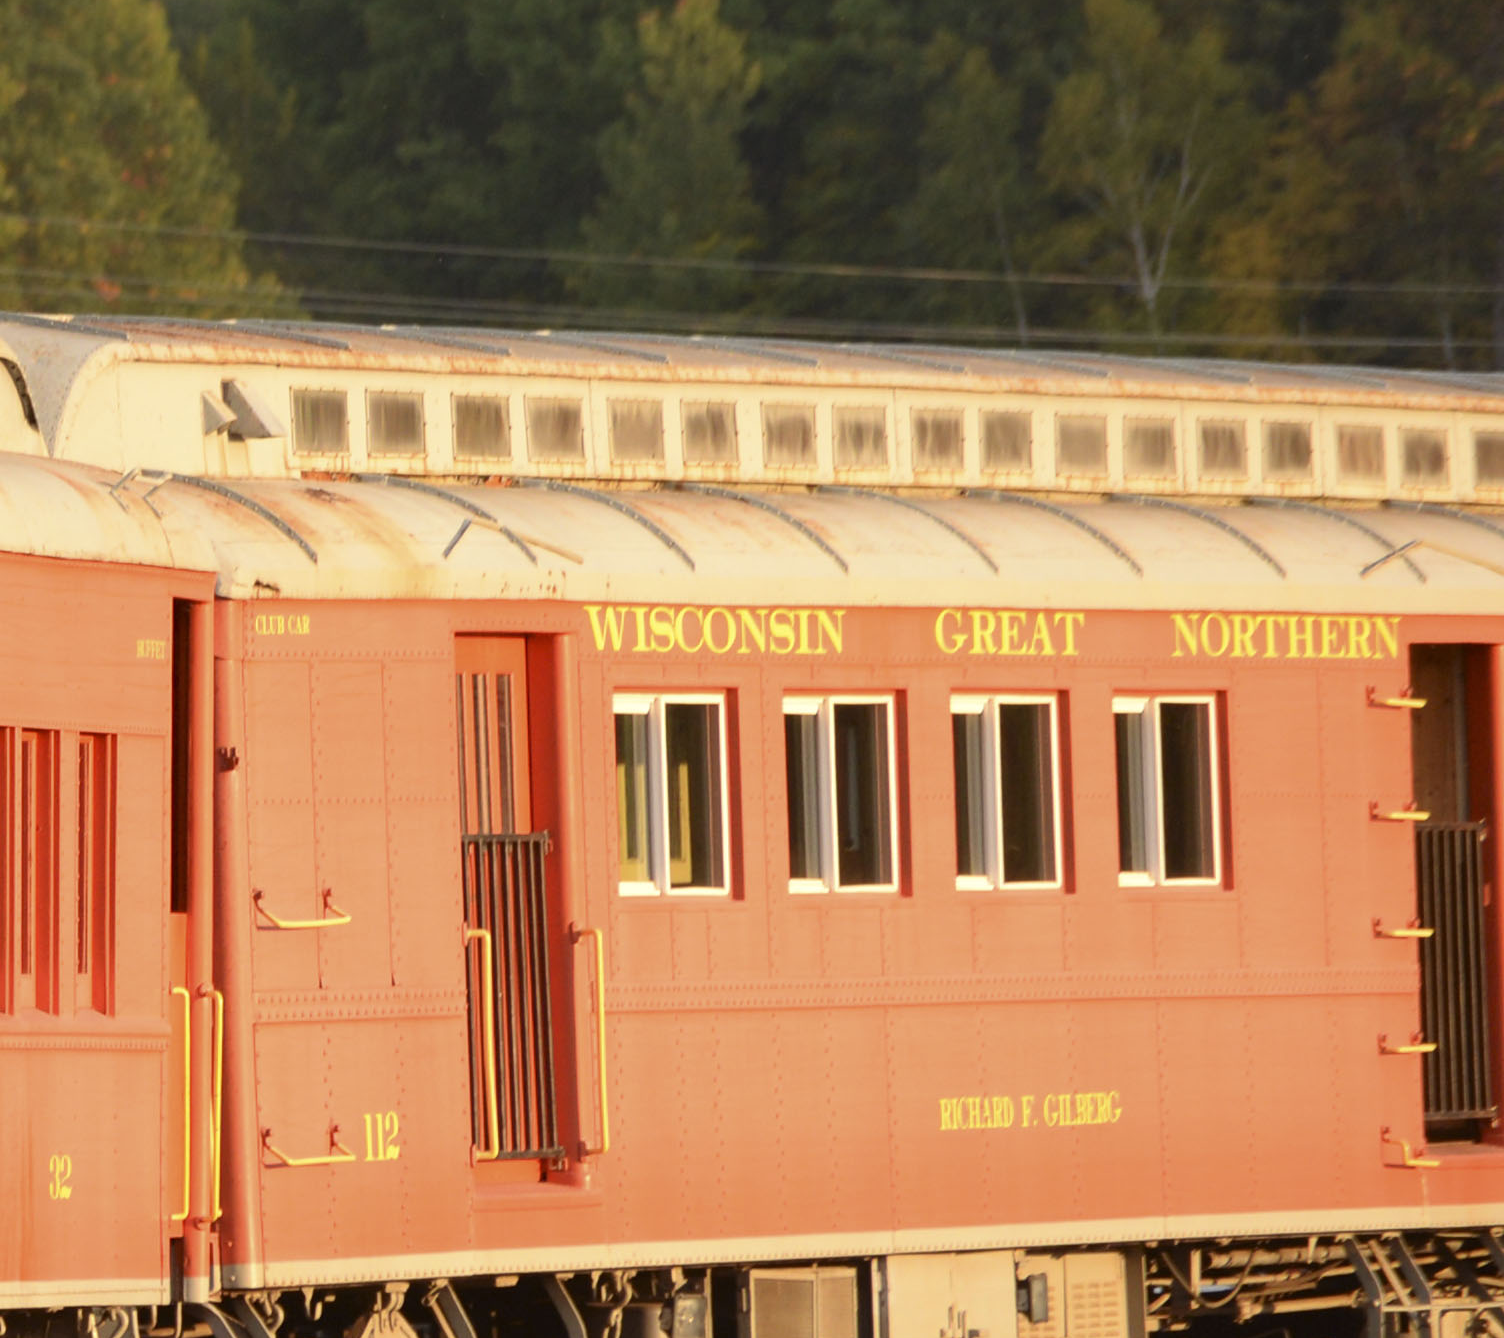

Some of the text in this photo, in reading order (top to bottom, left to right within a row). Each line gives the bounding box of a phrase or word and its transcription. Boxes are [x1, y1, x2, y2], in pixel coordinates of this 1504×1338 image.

[255, 614, 311, 636] CLUB CAR
[584, 605, 1402, 660] WISCONSIN GREAT NORTHERN
[939, 1094, 1015, 1131] RICHARD
[1043, 1090, 1123, 1127] GILBERG
[363, 1111, 401, 1162] 112
[49, 1154, 73, 1201] 32
